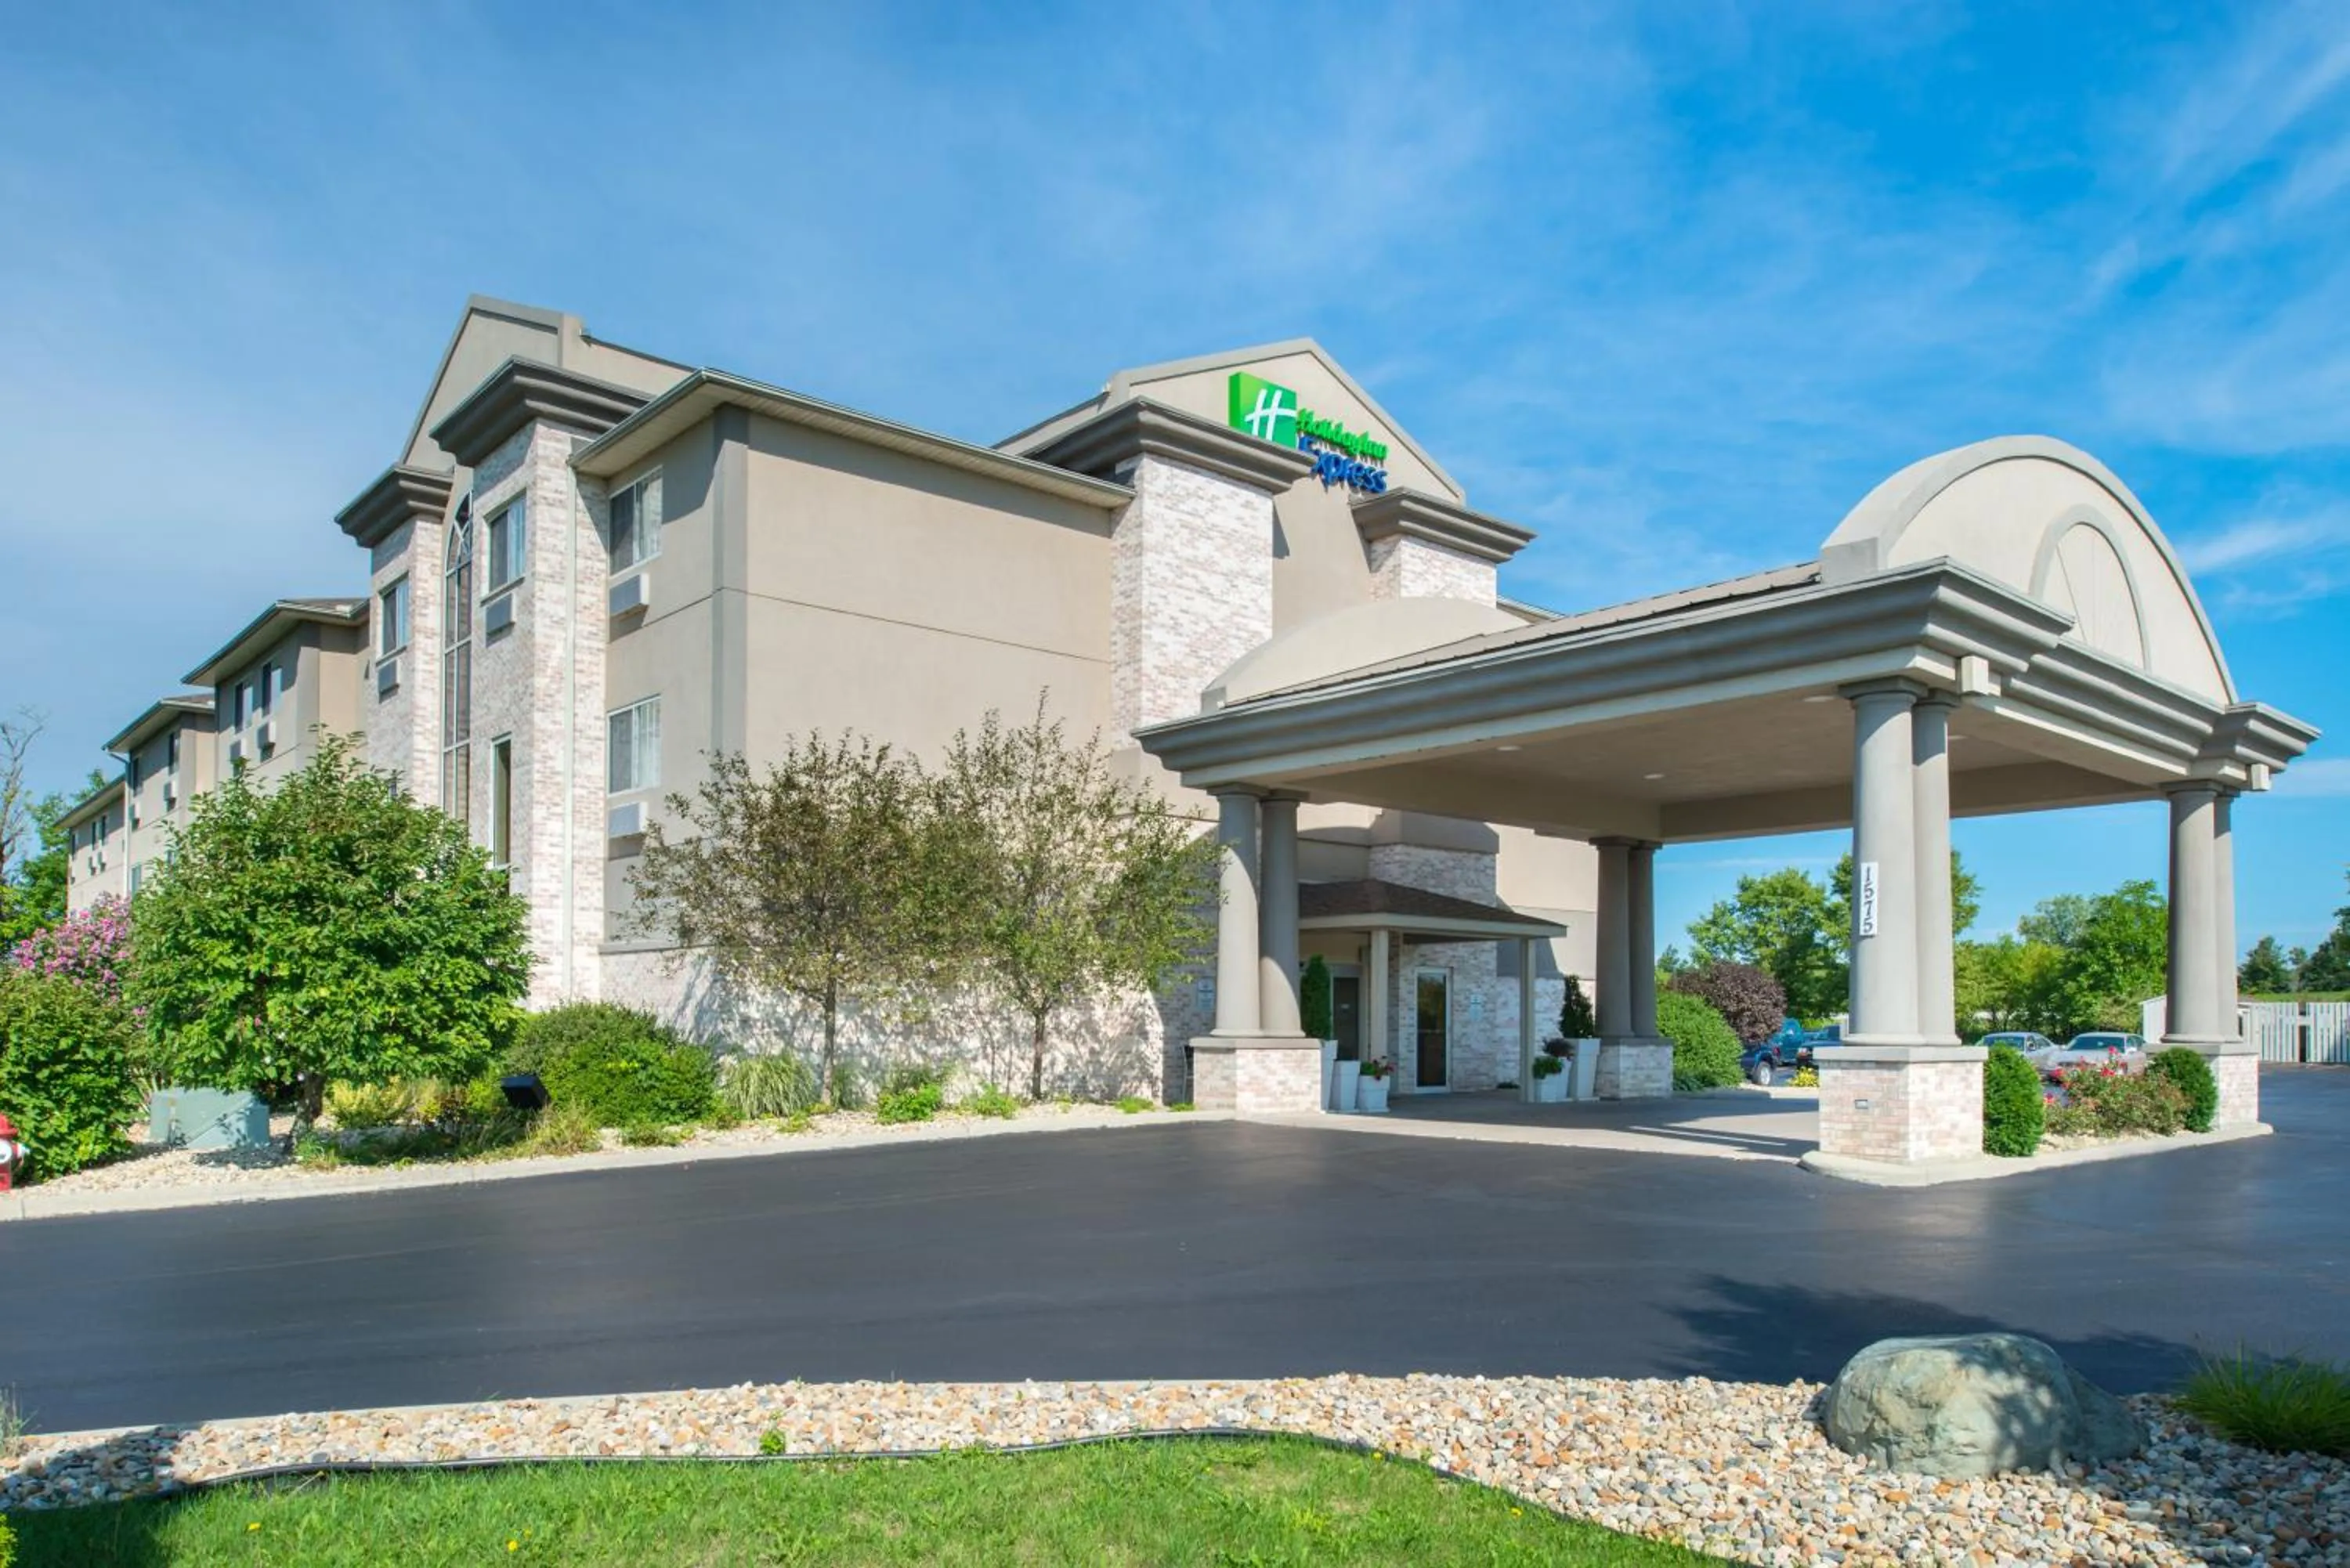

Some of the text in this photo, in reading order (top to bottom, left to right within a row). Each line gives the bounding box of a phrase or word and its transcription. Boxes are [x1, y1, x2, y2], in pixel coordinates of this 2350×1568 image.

[1296, 407, 1387, 461] Holiday Inn
[1863, 865, 1875, 934] 1575
